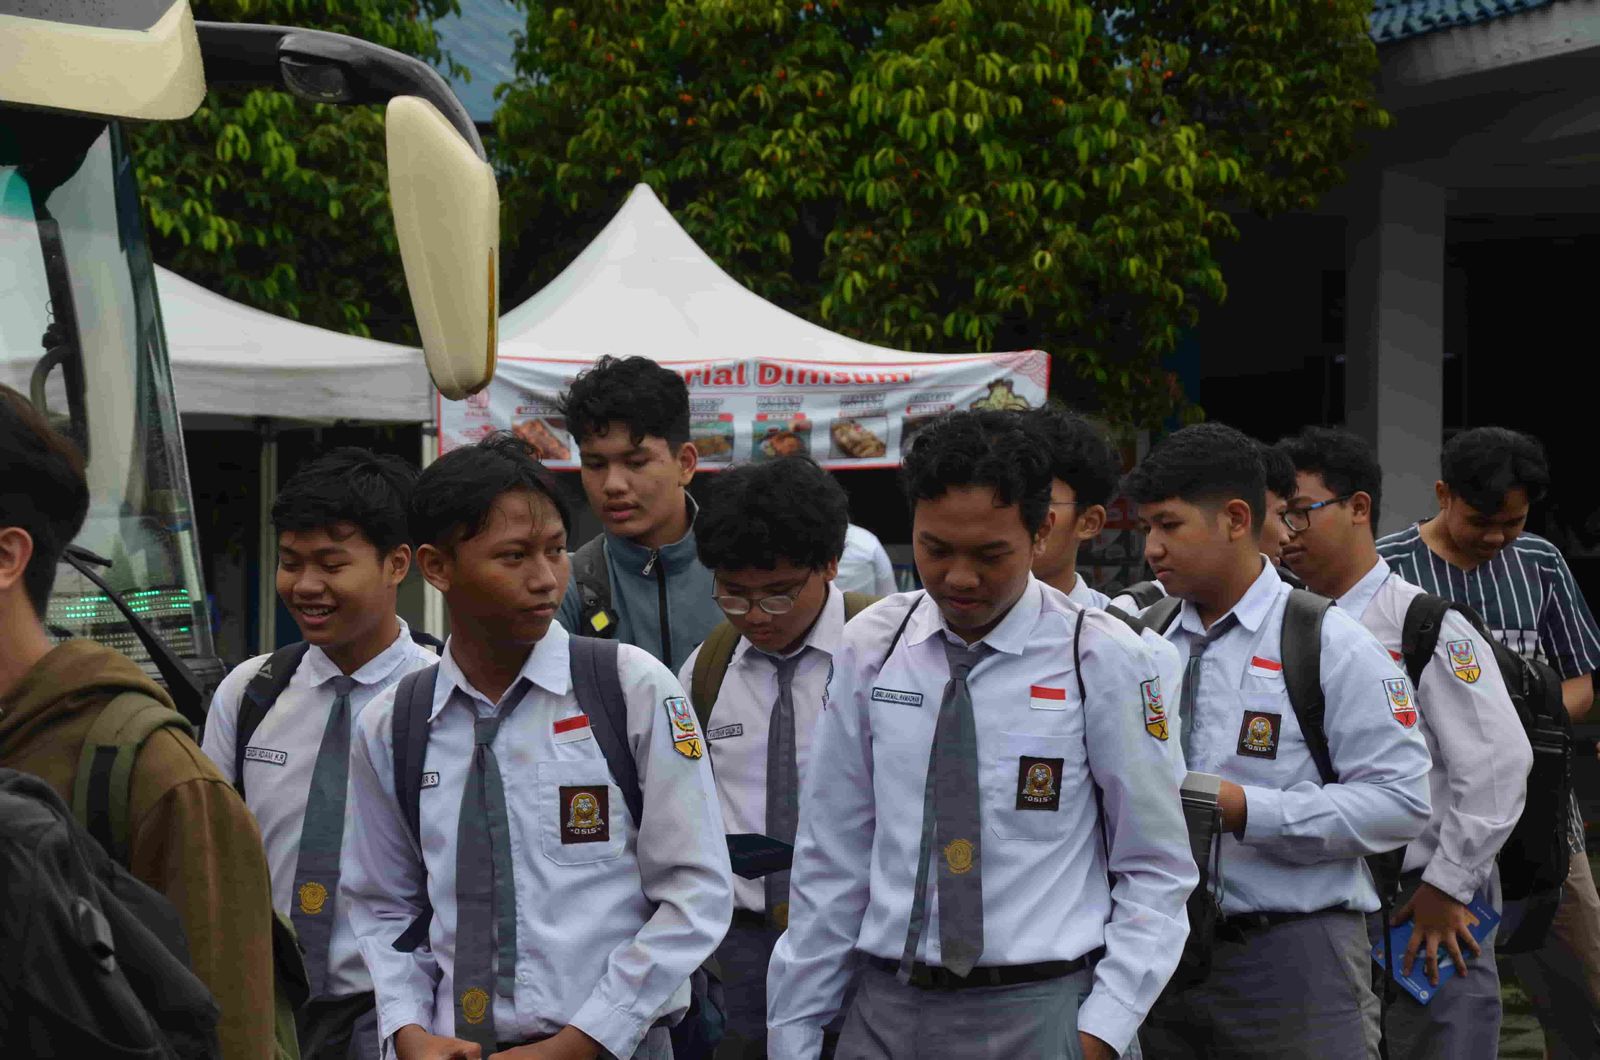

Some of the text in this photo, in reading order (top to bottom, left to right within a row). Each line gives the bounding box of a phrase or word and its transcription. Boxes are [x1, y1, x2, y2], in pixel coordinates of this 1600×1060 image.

[677, 362, 910, 385] rial Dimsum
[1027, 795, 1049, 803] OSIS
[574, 827, 597, 835] OSIS
